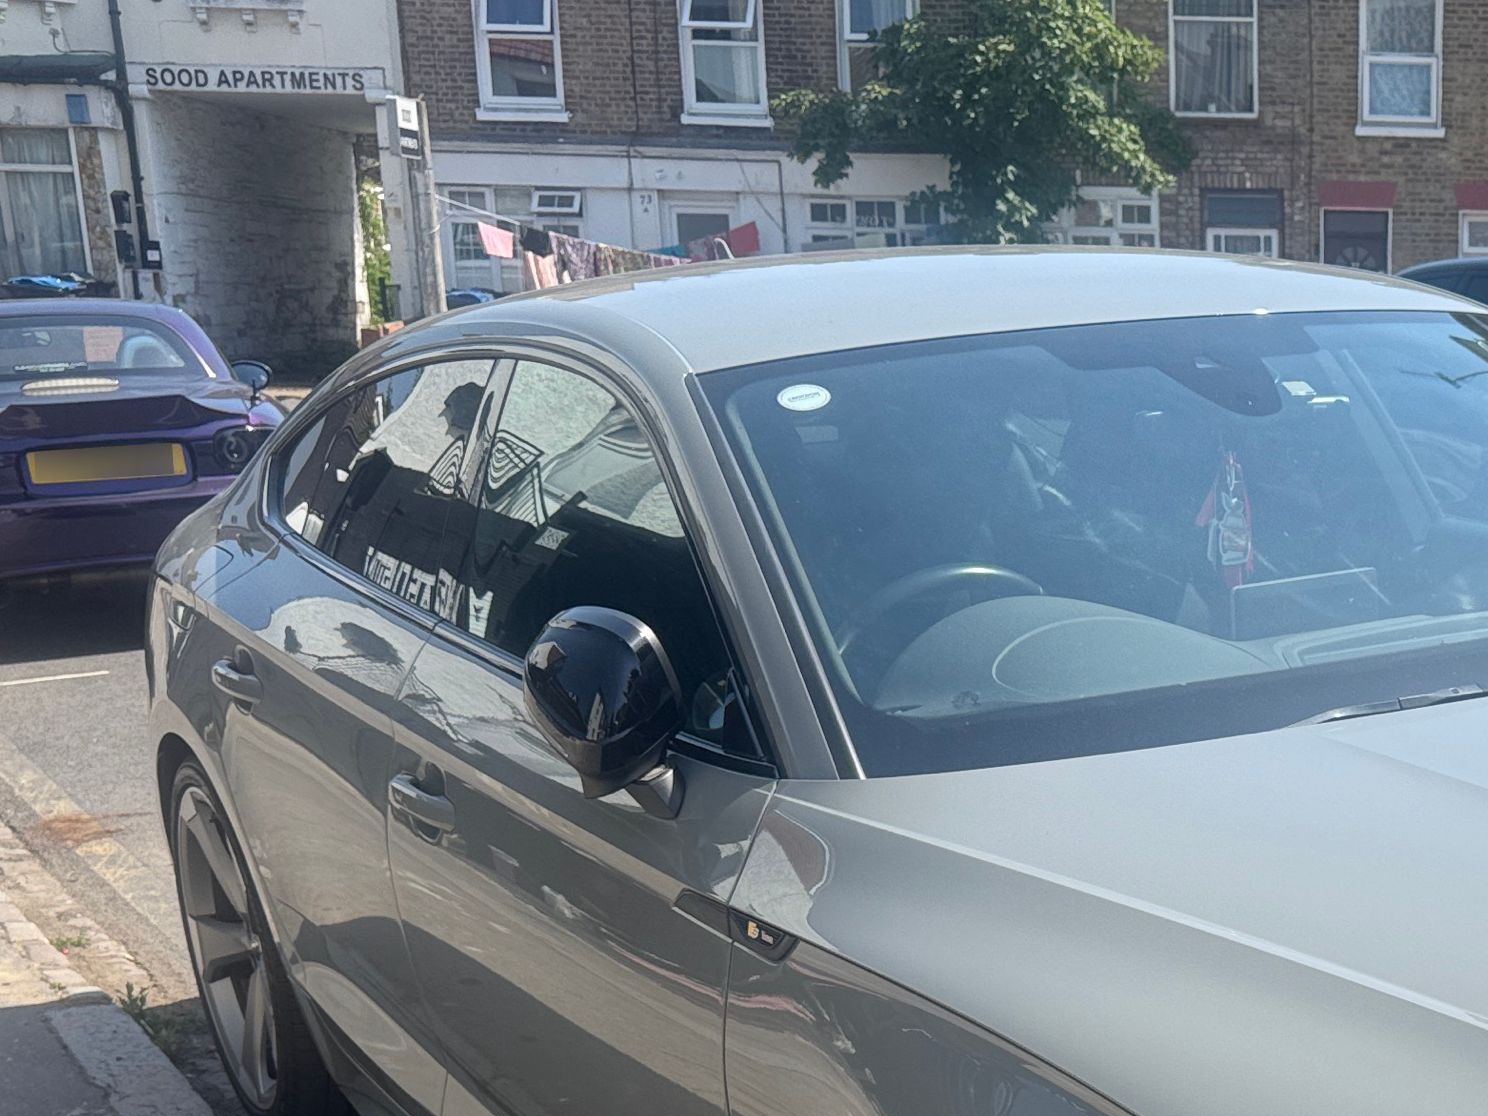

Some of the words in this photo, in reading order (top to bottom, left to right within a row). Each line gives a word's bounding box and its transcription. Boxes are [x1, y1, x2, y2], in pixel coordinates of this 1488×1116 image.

[145, 67, 209, 89] SOOD
[216, 69, 365, 91] APARTMENTS
[640, 194, 652, 205] 73
